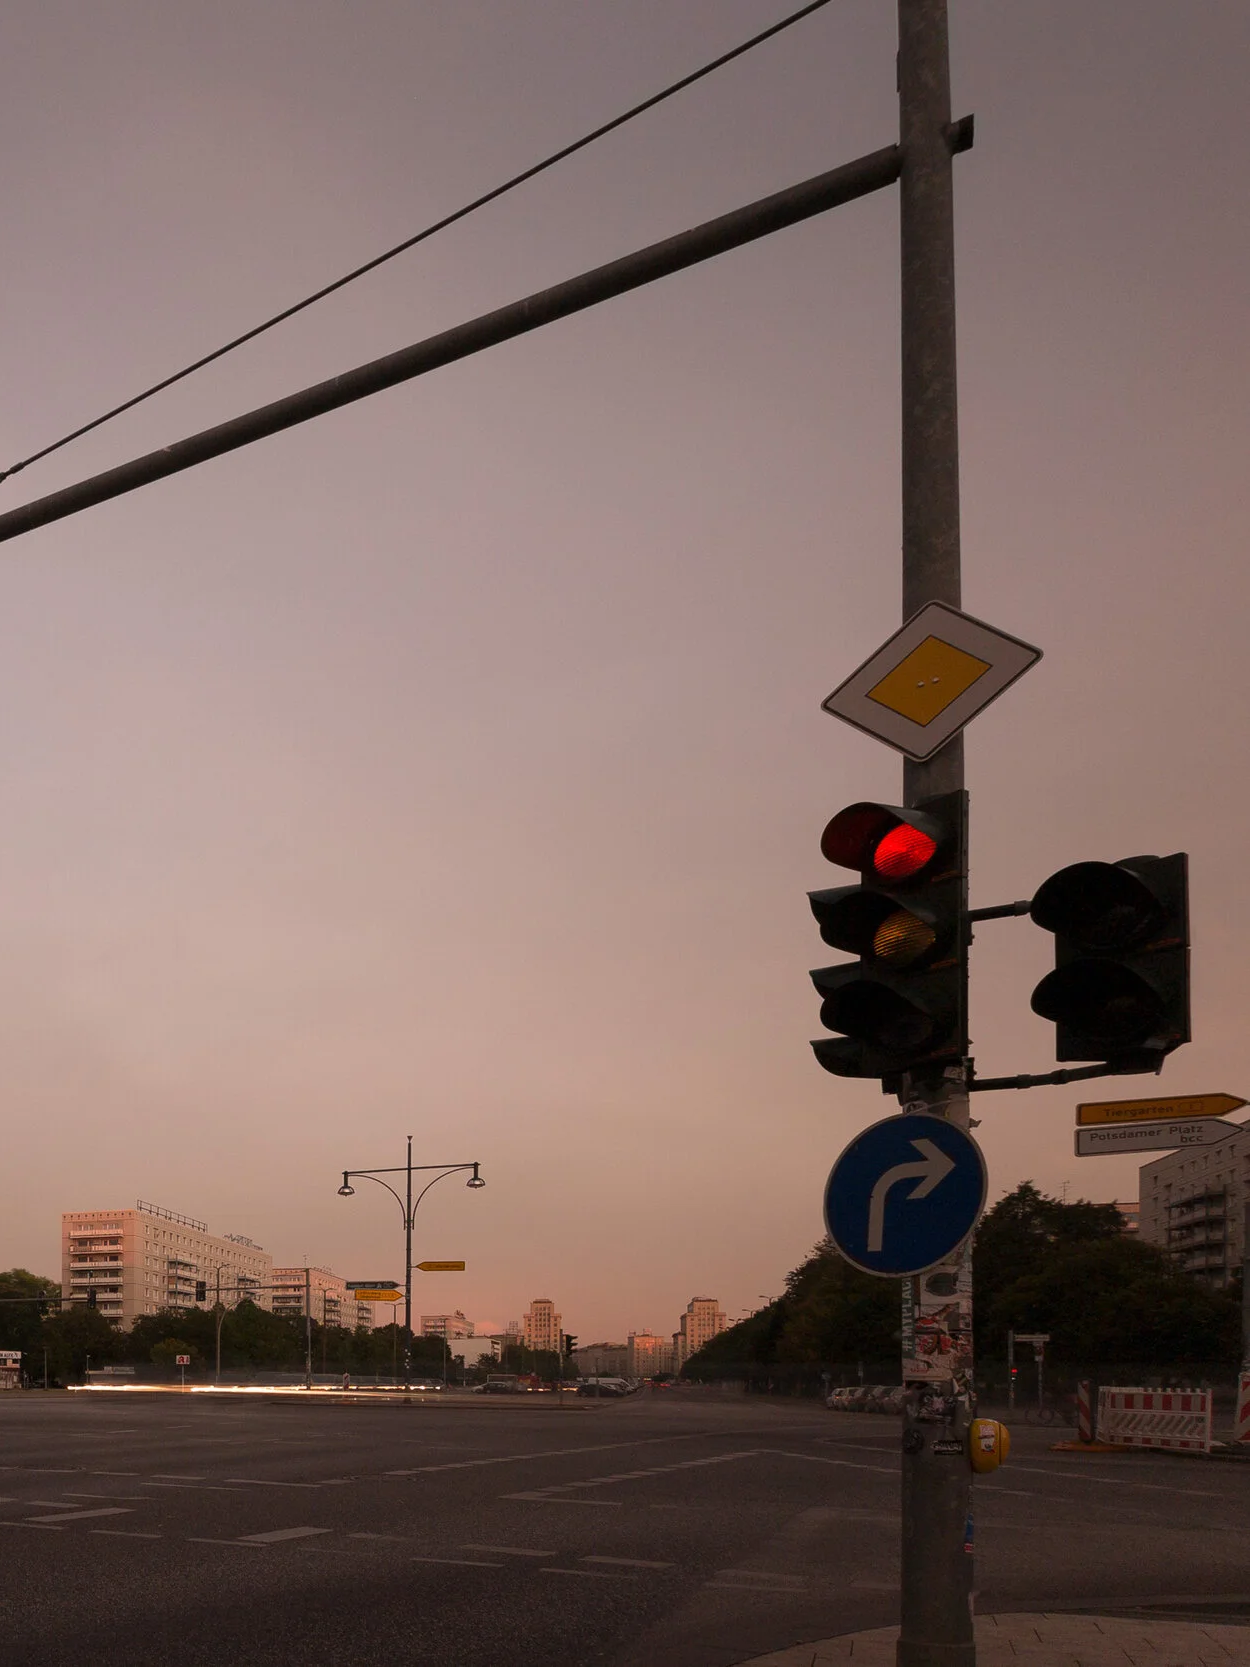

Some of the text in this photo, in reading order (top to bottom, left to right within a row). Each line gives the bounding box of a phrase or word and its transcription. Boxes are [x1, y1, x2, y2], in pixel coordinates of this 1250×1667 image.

[1104, 1105, 1174, 1118] Tiergarten
[1090, 1126, 1204, 1142] Potsdamer Platz
[1180, 1134, 1203, 1143] bcc
